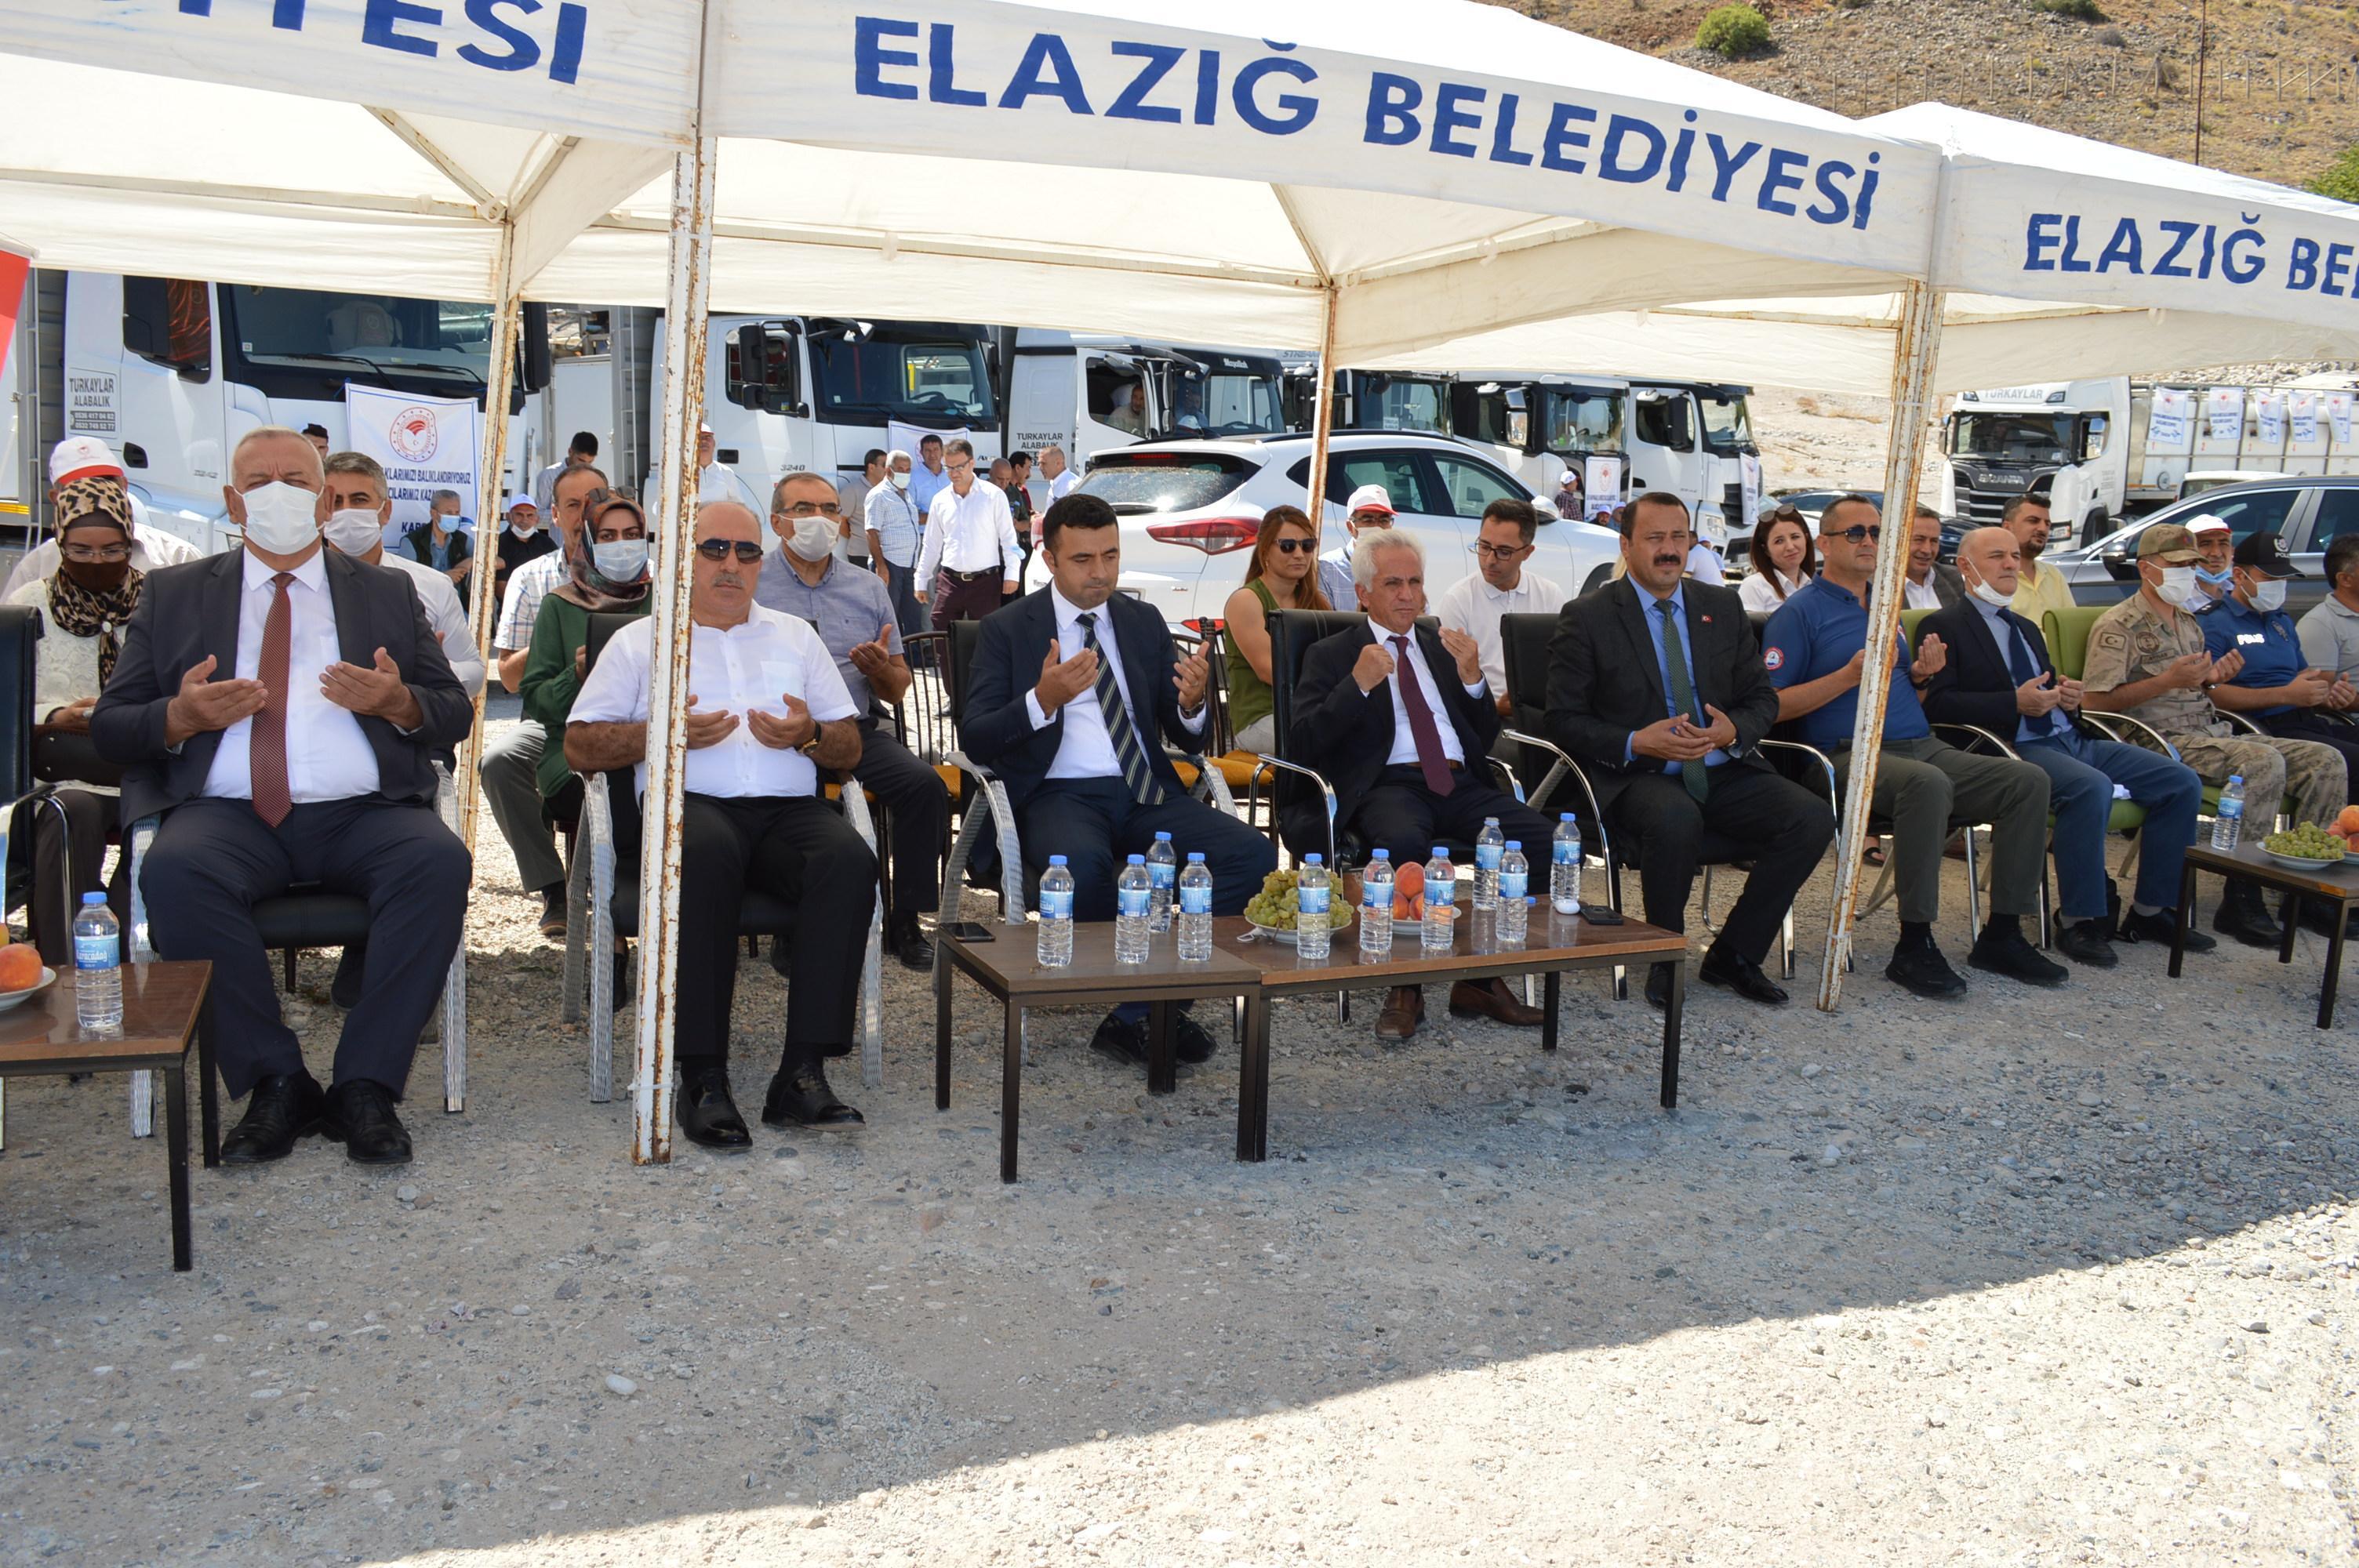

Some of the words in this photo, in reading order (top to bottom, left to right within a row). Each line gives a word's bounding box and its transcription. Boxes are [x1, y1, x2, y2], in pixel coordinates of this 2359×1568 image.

[855, 16, 1319, 135] ELAZIĞ
[1364, 71, 1881, 230] BELEDİYESİ
[2023, 212, 2266, 285] ELAZIĞ
[69, 378, 114, 393] TURKAYLAR
[74, 395, 111, 407] ALABALIK
